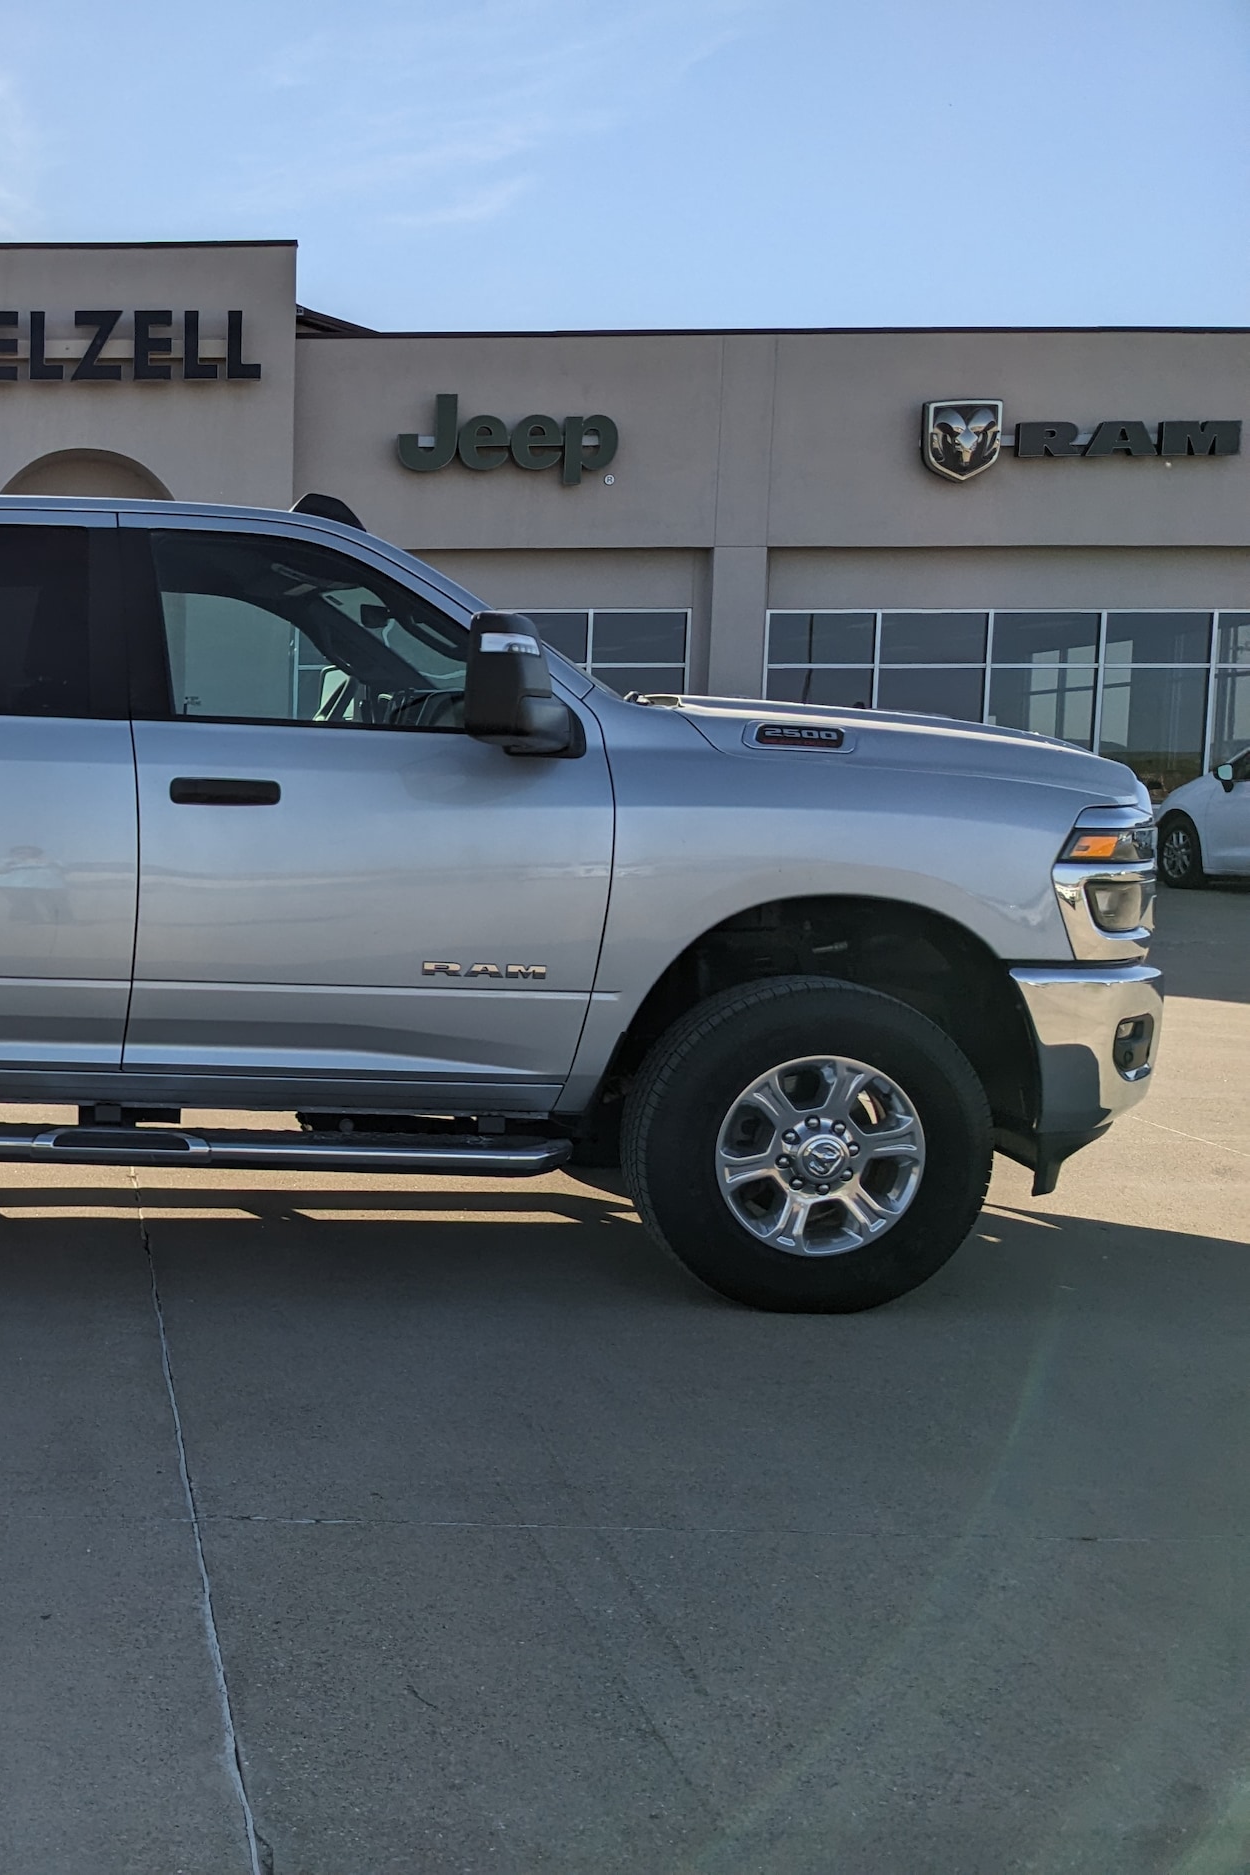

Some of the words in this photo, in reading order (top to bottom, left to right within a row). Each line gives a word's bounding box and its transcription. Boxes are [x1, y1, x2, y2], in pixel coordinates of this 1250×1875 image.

[397, 393, 618, 485] Jeep
[1014, 420, 1242, 457] RAM
[764, 727, 838, 740] 2500
[421, 960, 547, 980] RAM
